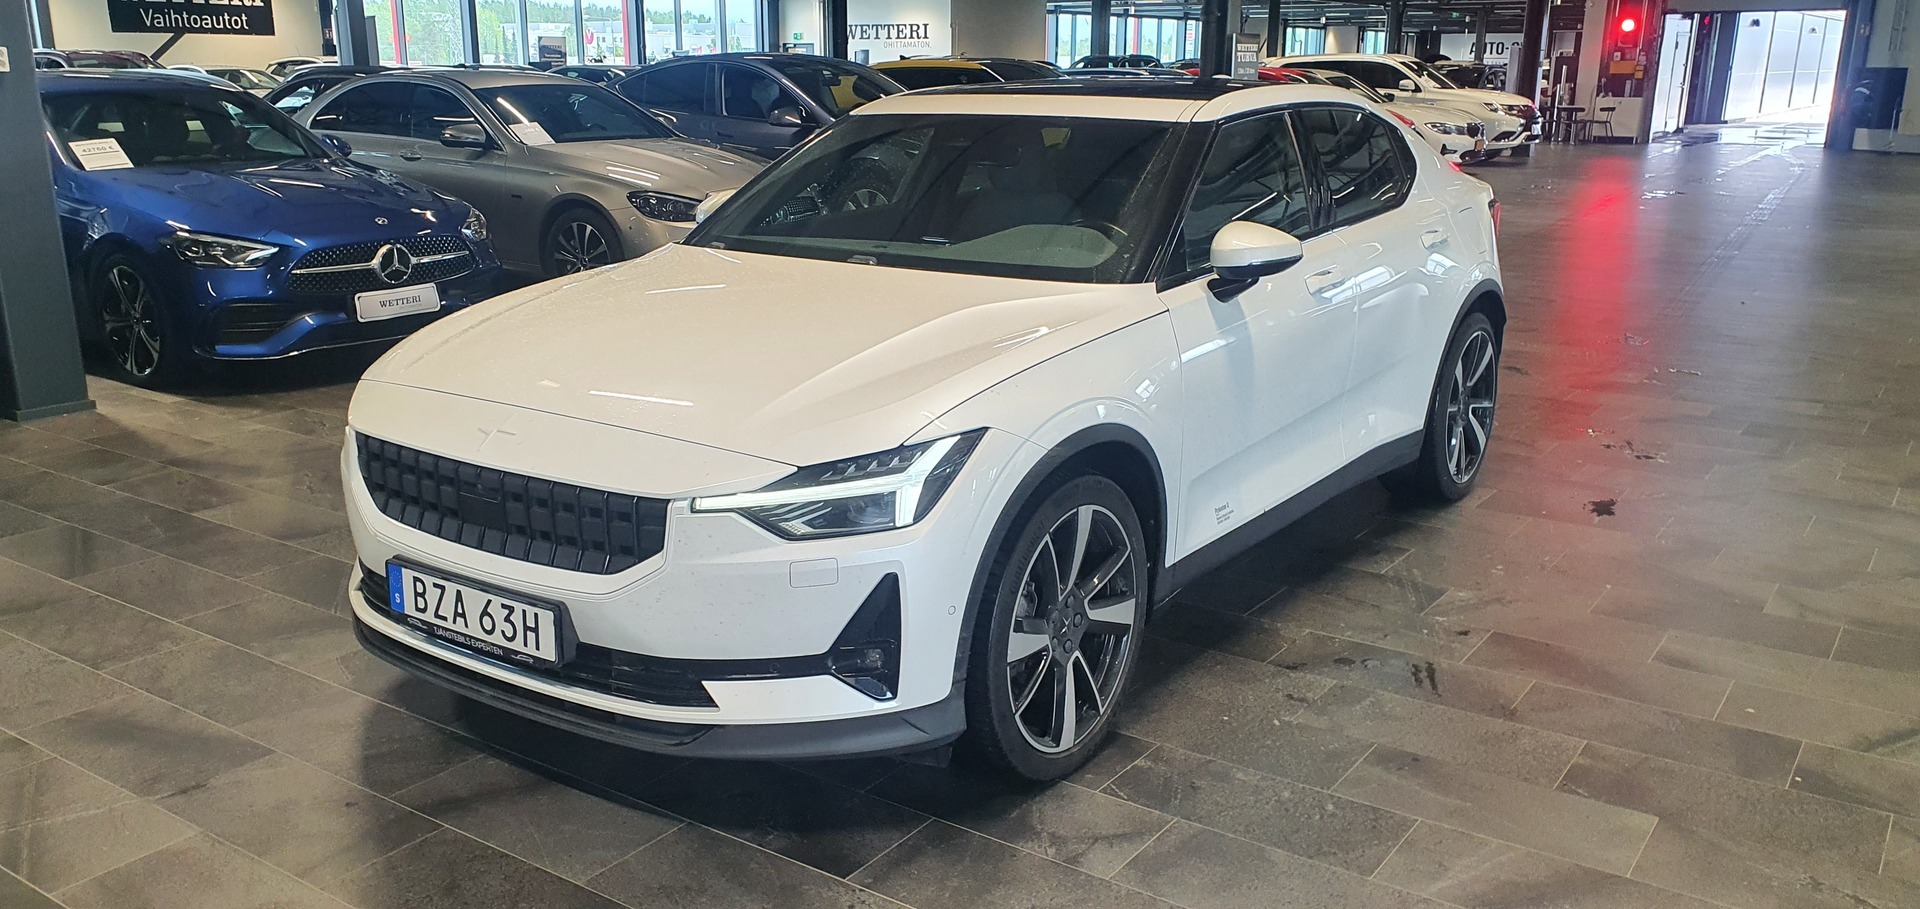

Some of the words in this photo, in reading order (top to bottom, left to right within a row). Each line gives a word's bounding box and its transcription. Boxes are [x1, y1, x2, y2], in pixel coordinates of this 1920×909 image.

[140, 8, 249, 29] Vaihtoautot
[847, 23, 929, 39] WETTERI
[379, 294, 421, 308] WETTERI
[395, 593, 401, 603] S
[412, 575, 469, 629] BZA
[479, 598, 541, 652] 63H
